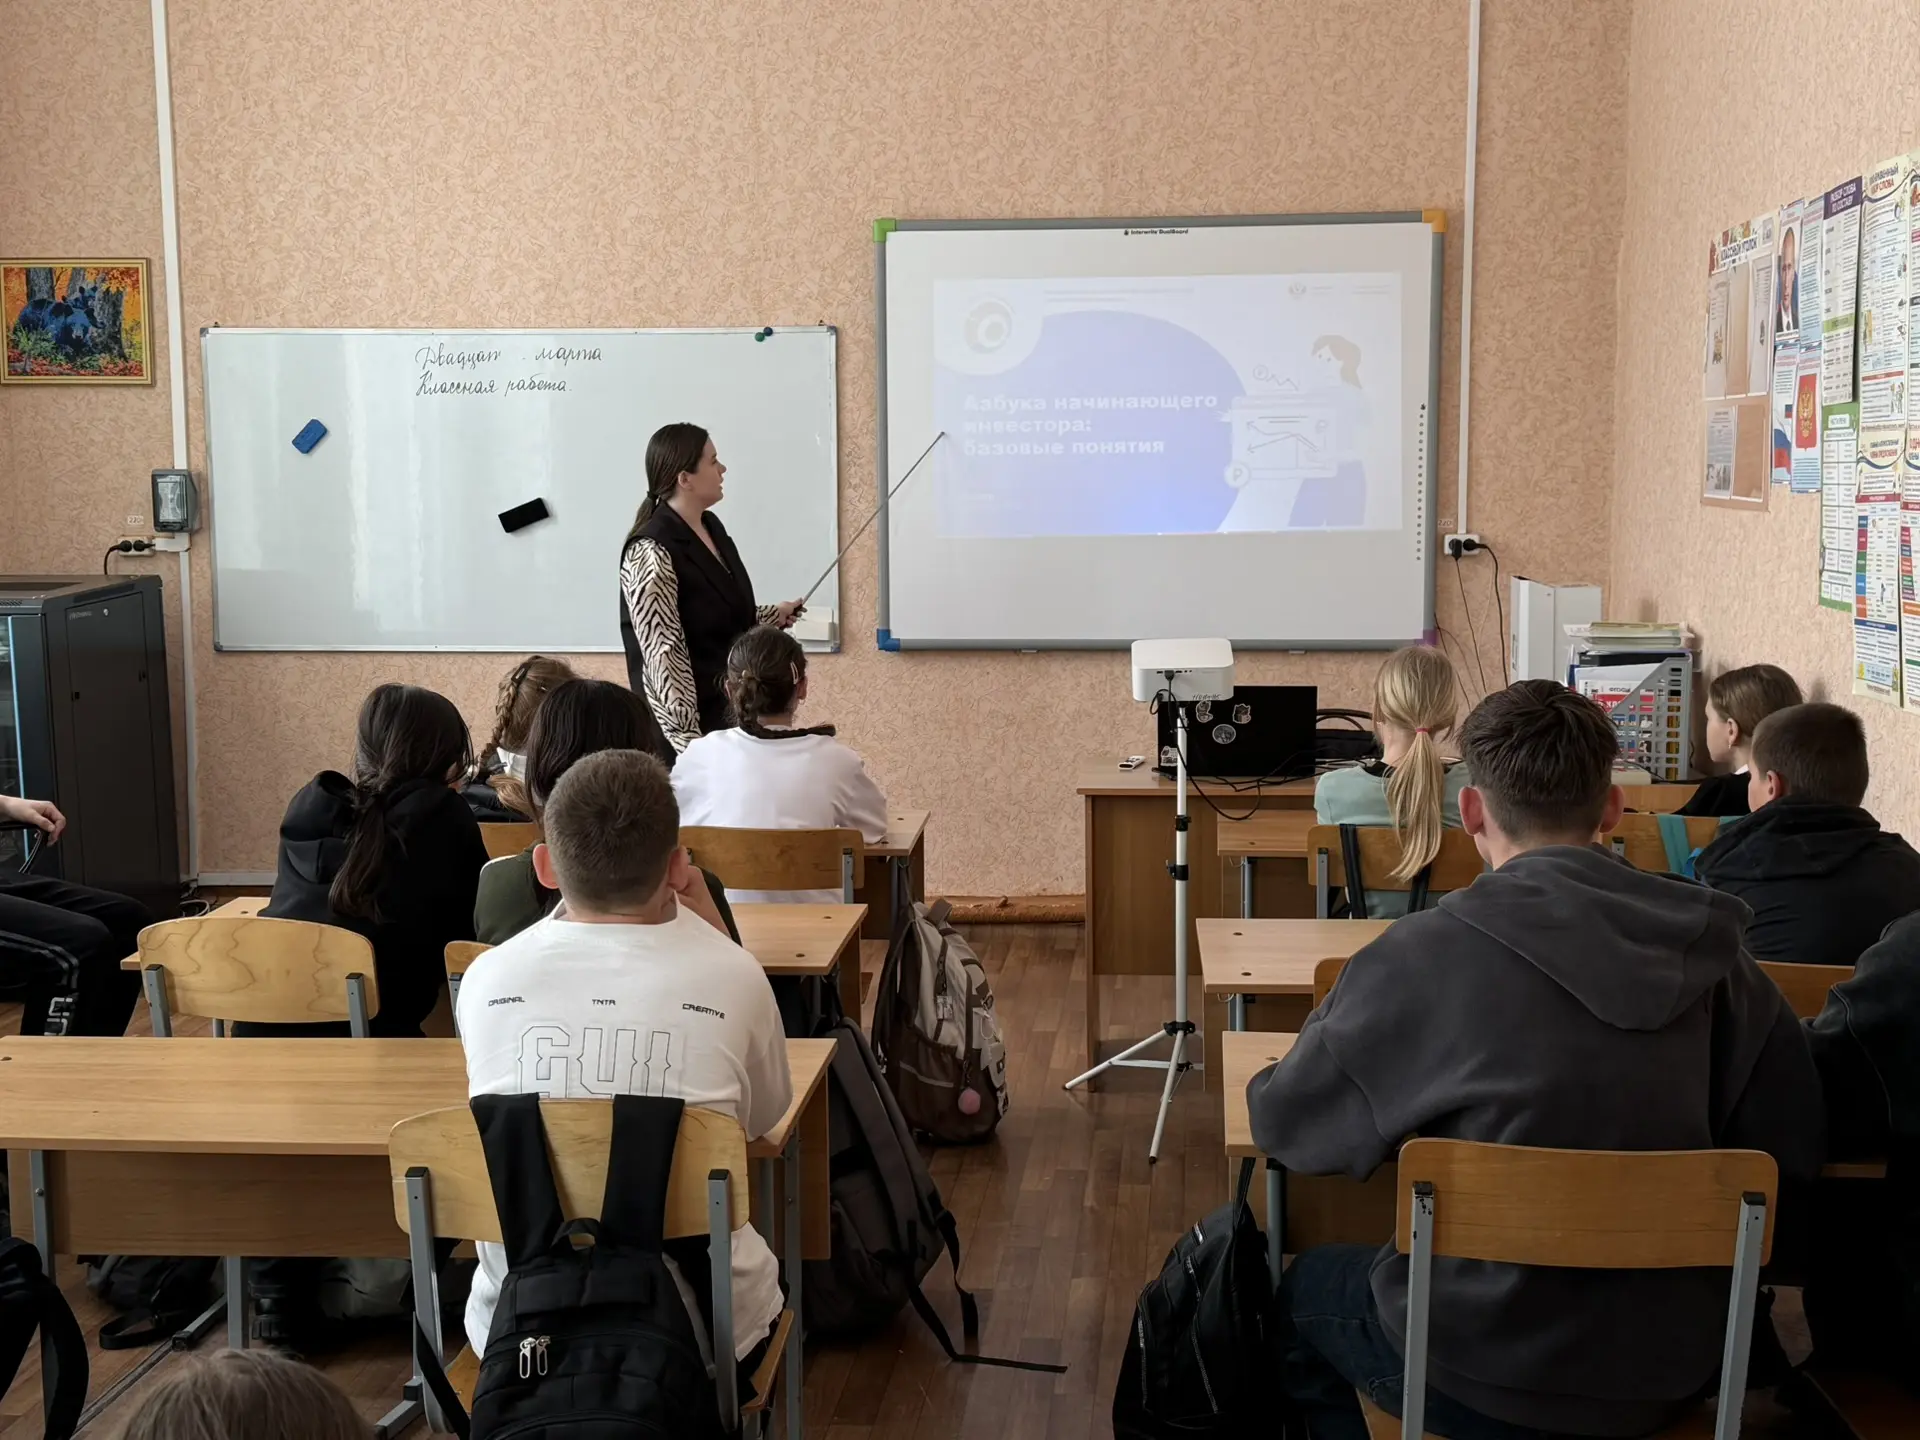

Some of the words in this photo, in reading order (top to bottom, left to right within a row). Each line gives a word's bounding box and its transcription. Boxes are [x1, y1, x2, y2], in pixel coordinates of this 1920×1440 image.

[535, 346, 602, 366] марта
[416, 370, 499, 396] Классная
[964, 394, 1047, 414] Азбука
[1054, 395, 1218, 411] начинающего
[963, 418, 1092, 436] инвестора:
[963, 440, 1065, 456] базовые
[1072, 439, 1165, 455] понятия
[682, 1003, 726, 1020] CREATIVE
